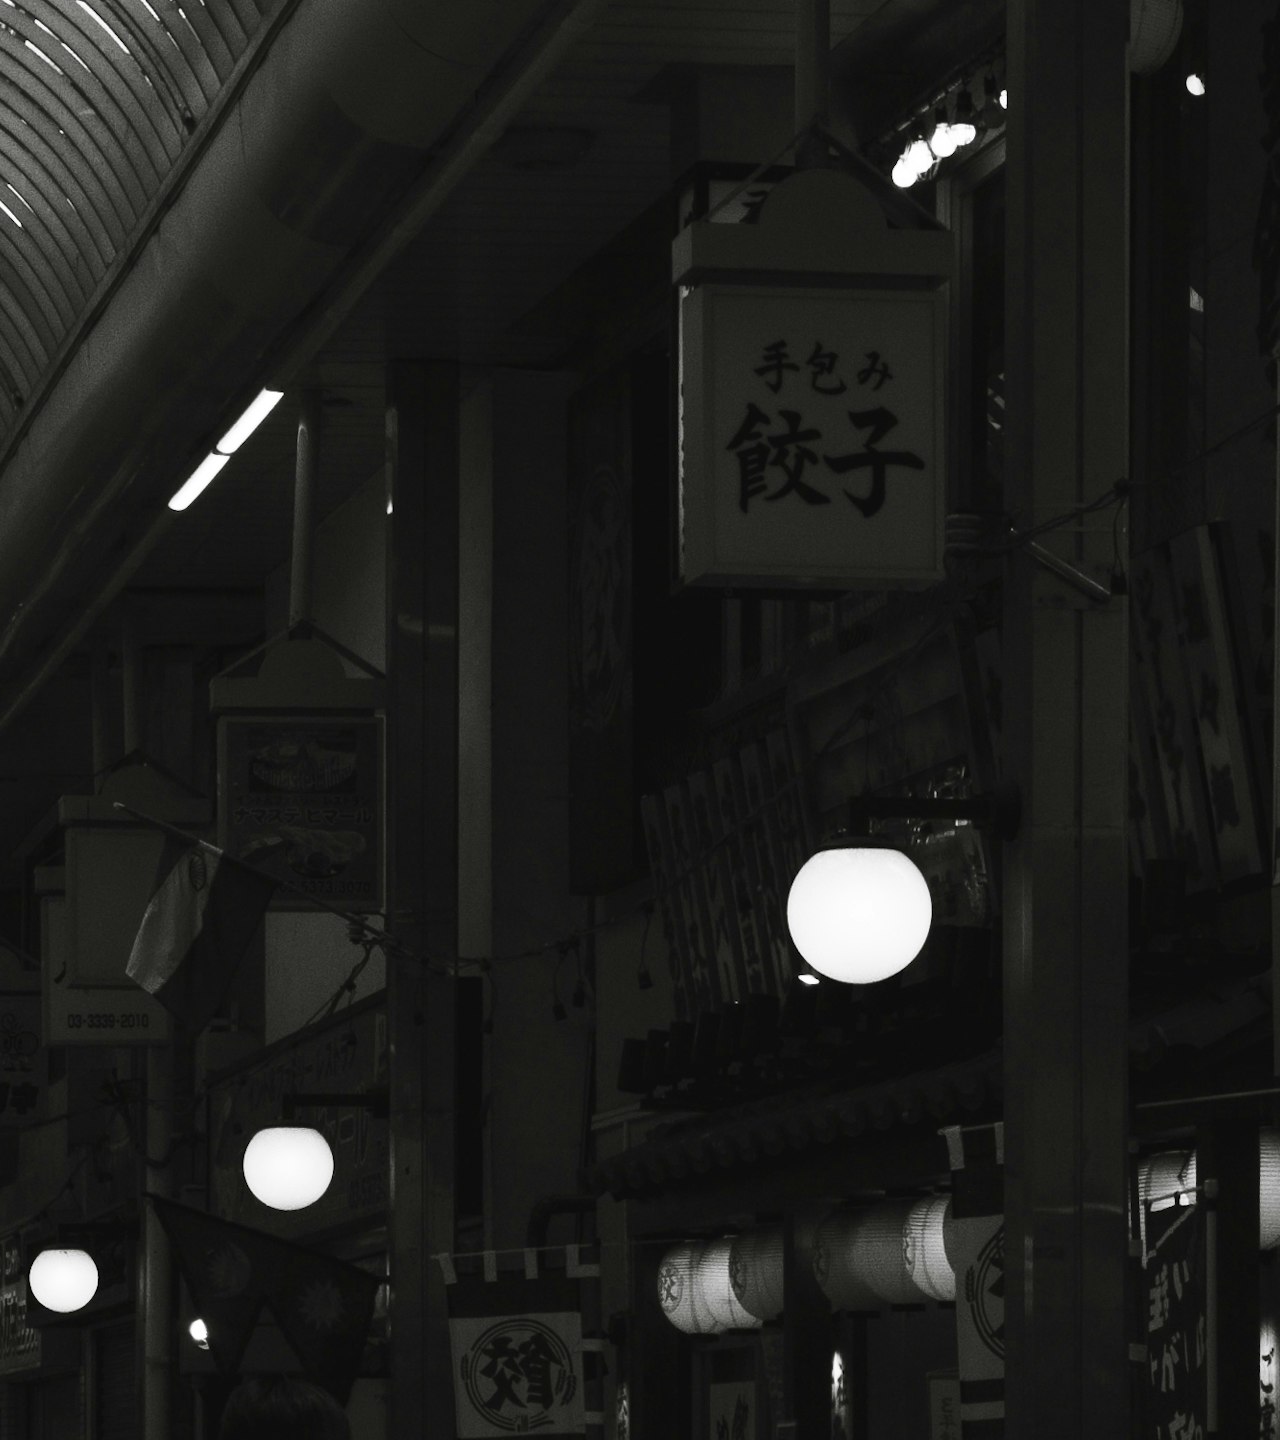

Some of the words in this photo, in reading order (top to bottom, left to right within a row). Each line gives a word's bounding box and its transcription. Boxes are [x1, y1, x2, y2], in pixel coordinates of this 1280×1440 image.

[753, 338, 895, 397] 手包み
[725, 401, 926, 519] 餃子
[233, 806, 300, 825] ナマステ
[305, 807, 374, 825] ヒマール
[67, 1013, 149, 1029] 03-3339-2010
